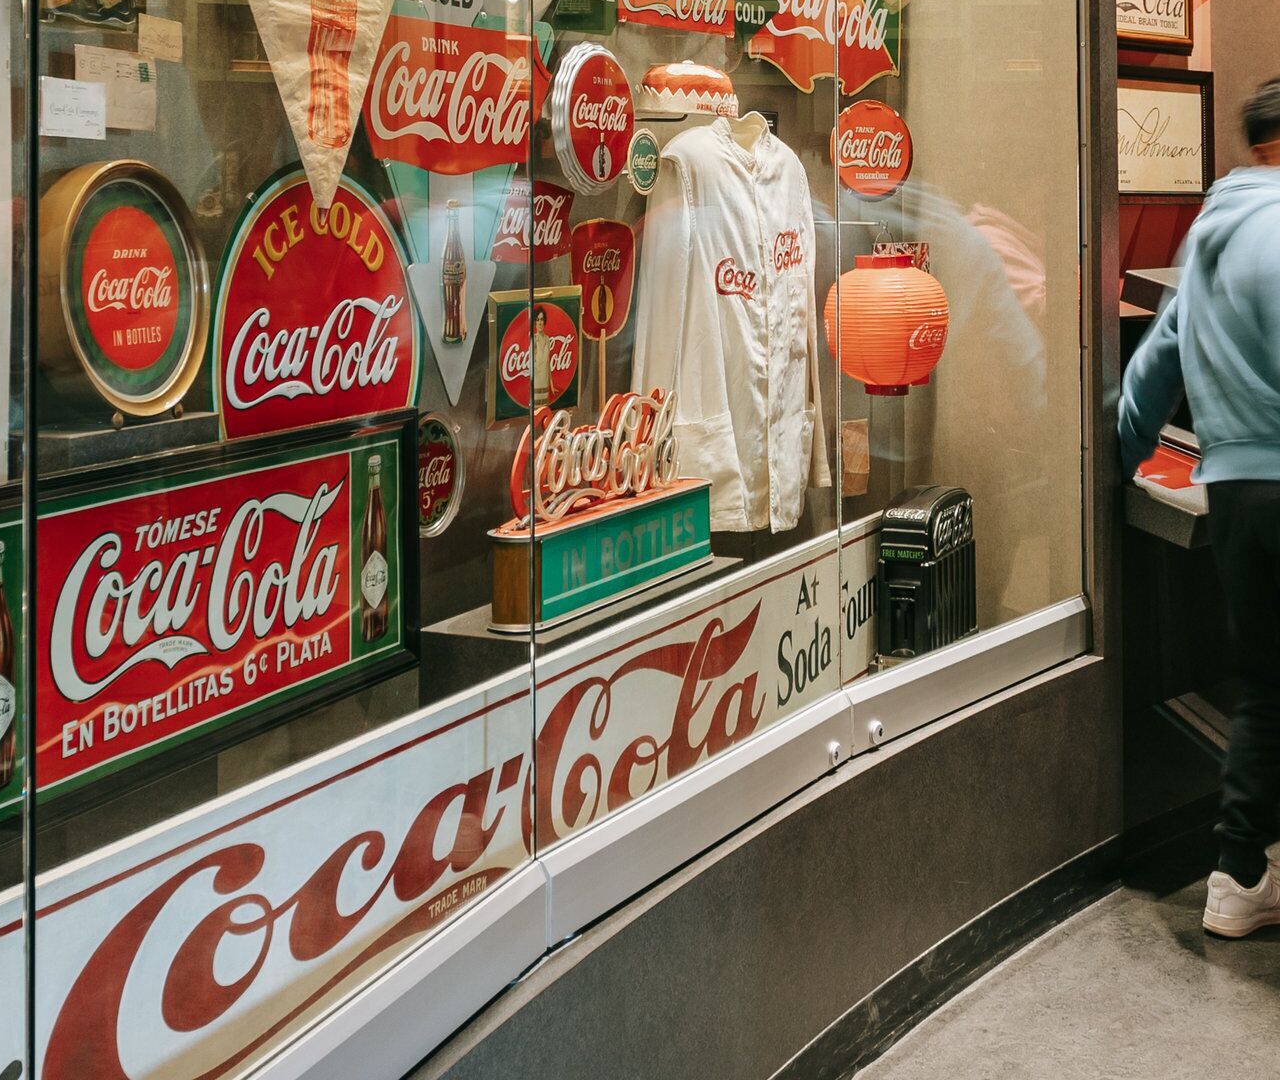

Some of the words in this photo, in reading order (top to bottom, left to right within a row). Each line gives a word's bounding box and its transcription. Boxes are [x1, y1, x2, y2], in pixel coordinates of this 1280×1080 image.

[734, 0, 766, 25] COLD
[1138, 16, 1159, 27] BRAIN
[421, 36, 460, 56] DRINK
[370, 40, 530, 145] Coca-Cola
[592, 75, 613, 87] DRINK
[572, 92, 630, 132] Coca-Cola
[838, 129, 904, 169] Coca-Cola
[111, 248, 148, 261] DRINK
[251, 207, 306, 280] ICE
[313, 200, 386, 274] COLD
[582, 248, 621, 274] Coca-Cola
[714, 256, 758, 301] Coca
[771, 230, 803, 273] Cola
[87, 265, 173, 312] Coca-Cola
[112, 328, 124, 347] IN
[125, 326, 162, 346] BOTTLES
[224, 293, 405, 410] Coca-Cola
[502, 334, 575, 381] Cocaola
[510, 387, 681, 521] Coca-Cola
[133, 505, 223, 553] TÓMESE
[561, 549, 587, 593] IN
[600, 508, 696, 577] BOTTLES
[882, 549, 896, 558] FREE
[50, 474, 348, 703] Coca-Cola
[795, 571, 820, 616] At
[243, 655, 269, 686] 6¢
[777, 616, 832, 710] Soda
[42, 599, 765, 1080] Coca-Cola
[428, 888, 458, 919] TRADE
[462, 875, 488, 899] MARK
